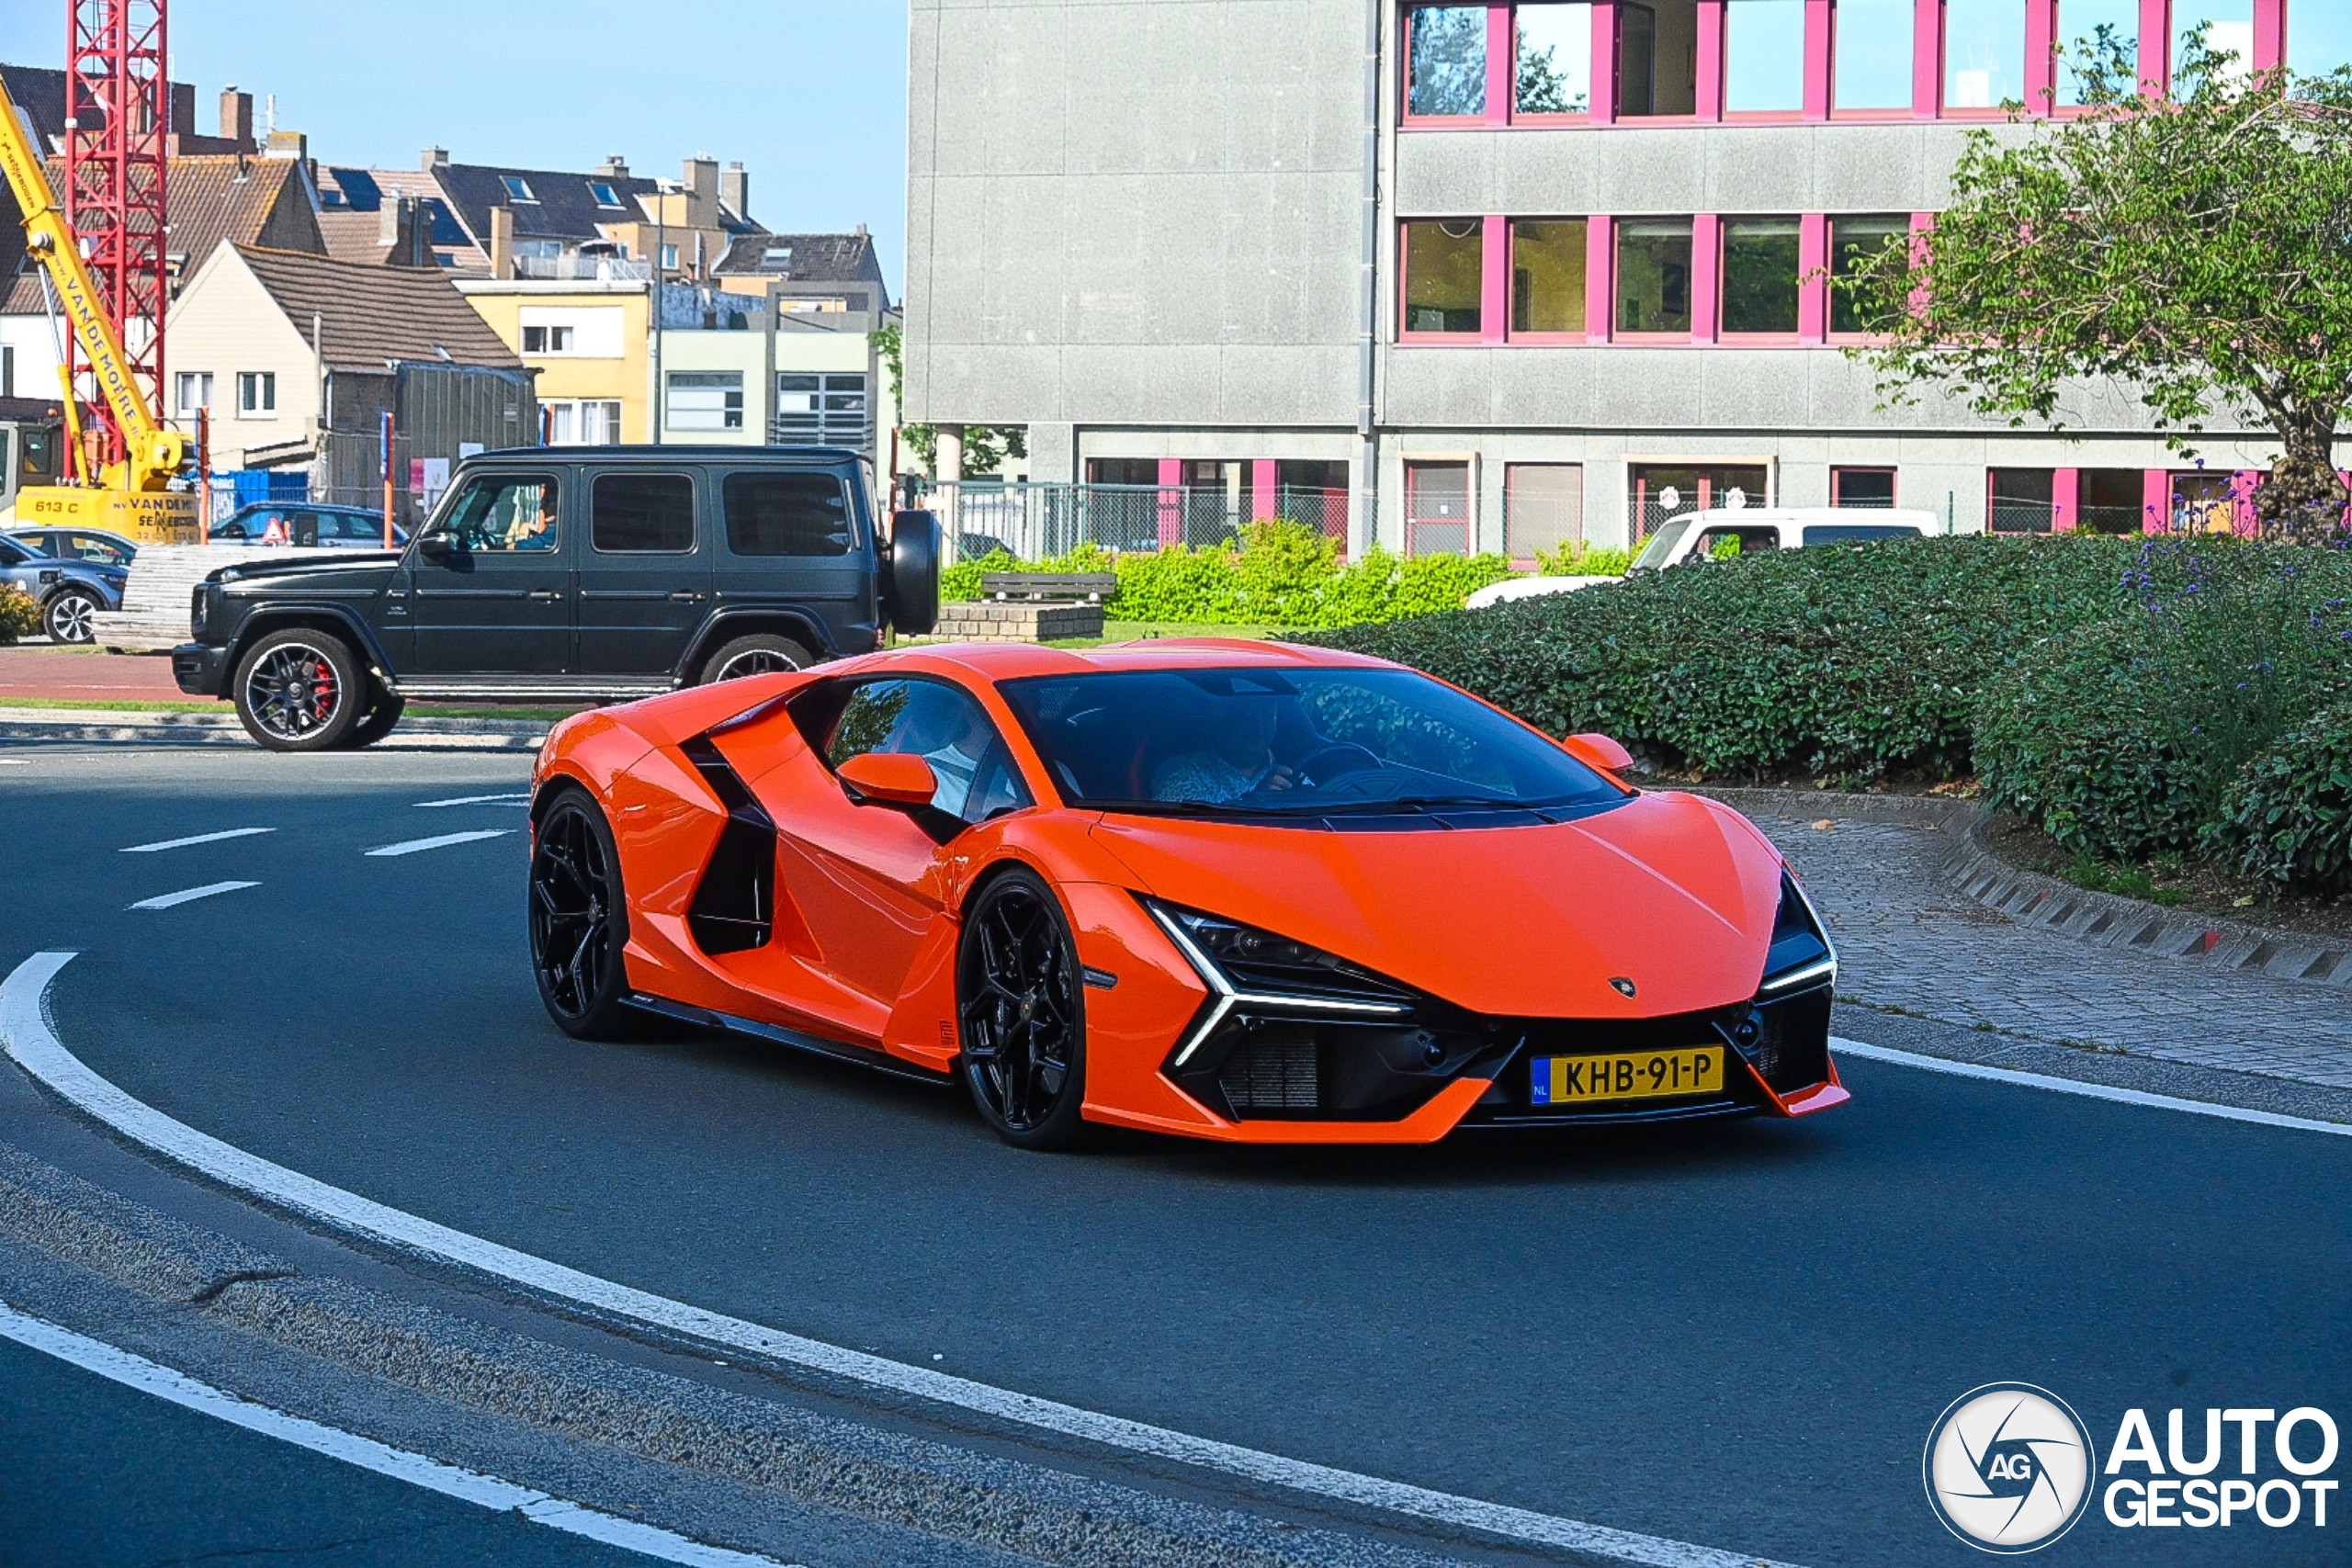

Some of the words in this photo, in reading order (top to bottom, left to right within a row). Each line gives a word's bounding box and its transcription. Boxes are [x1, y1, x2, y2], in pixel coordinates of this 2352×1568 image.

[36, 501, 62, 513] 613
[68, 502, 79, 513] C
[1533, 1085, 1547, 1096] NL
[1566, 1054, 1712, 1096] KHB-91-P
